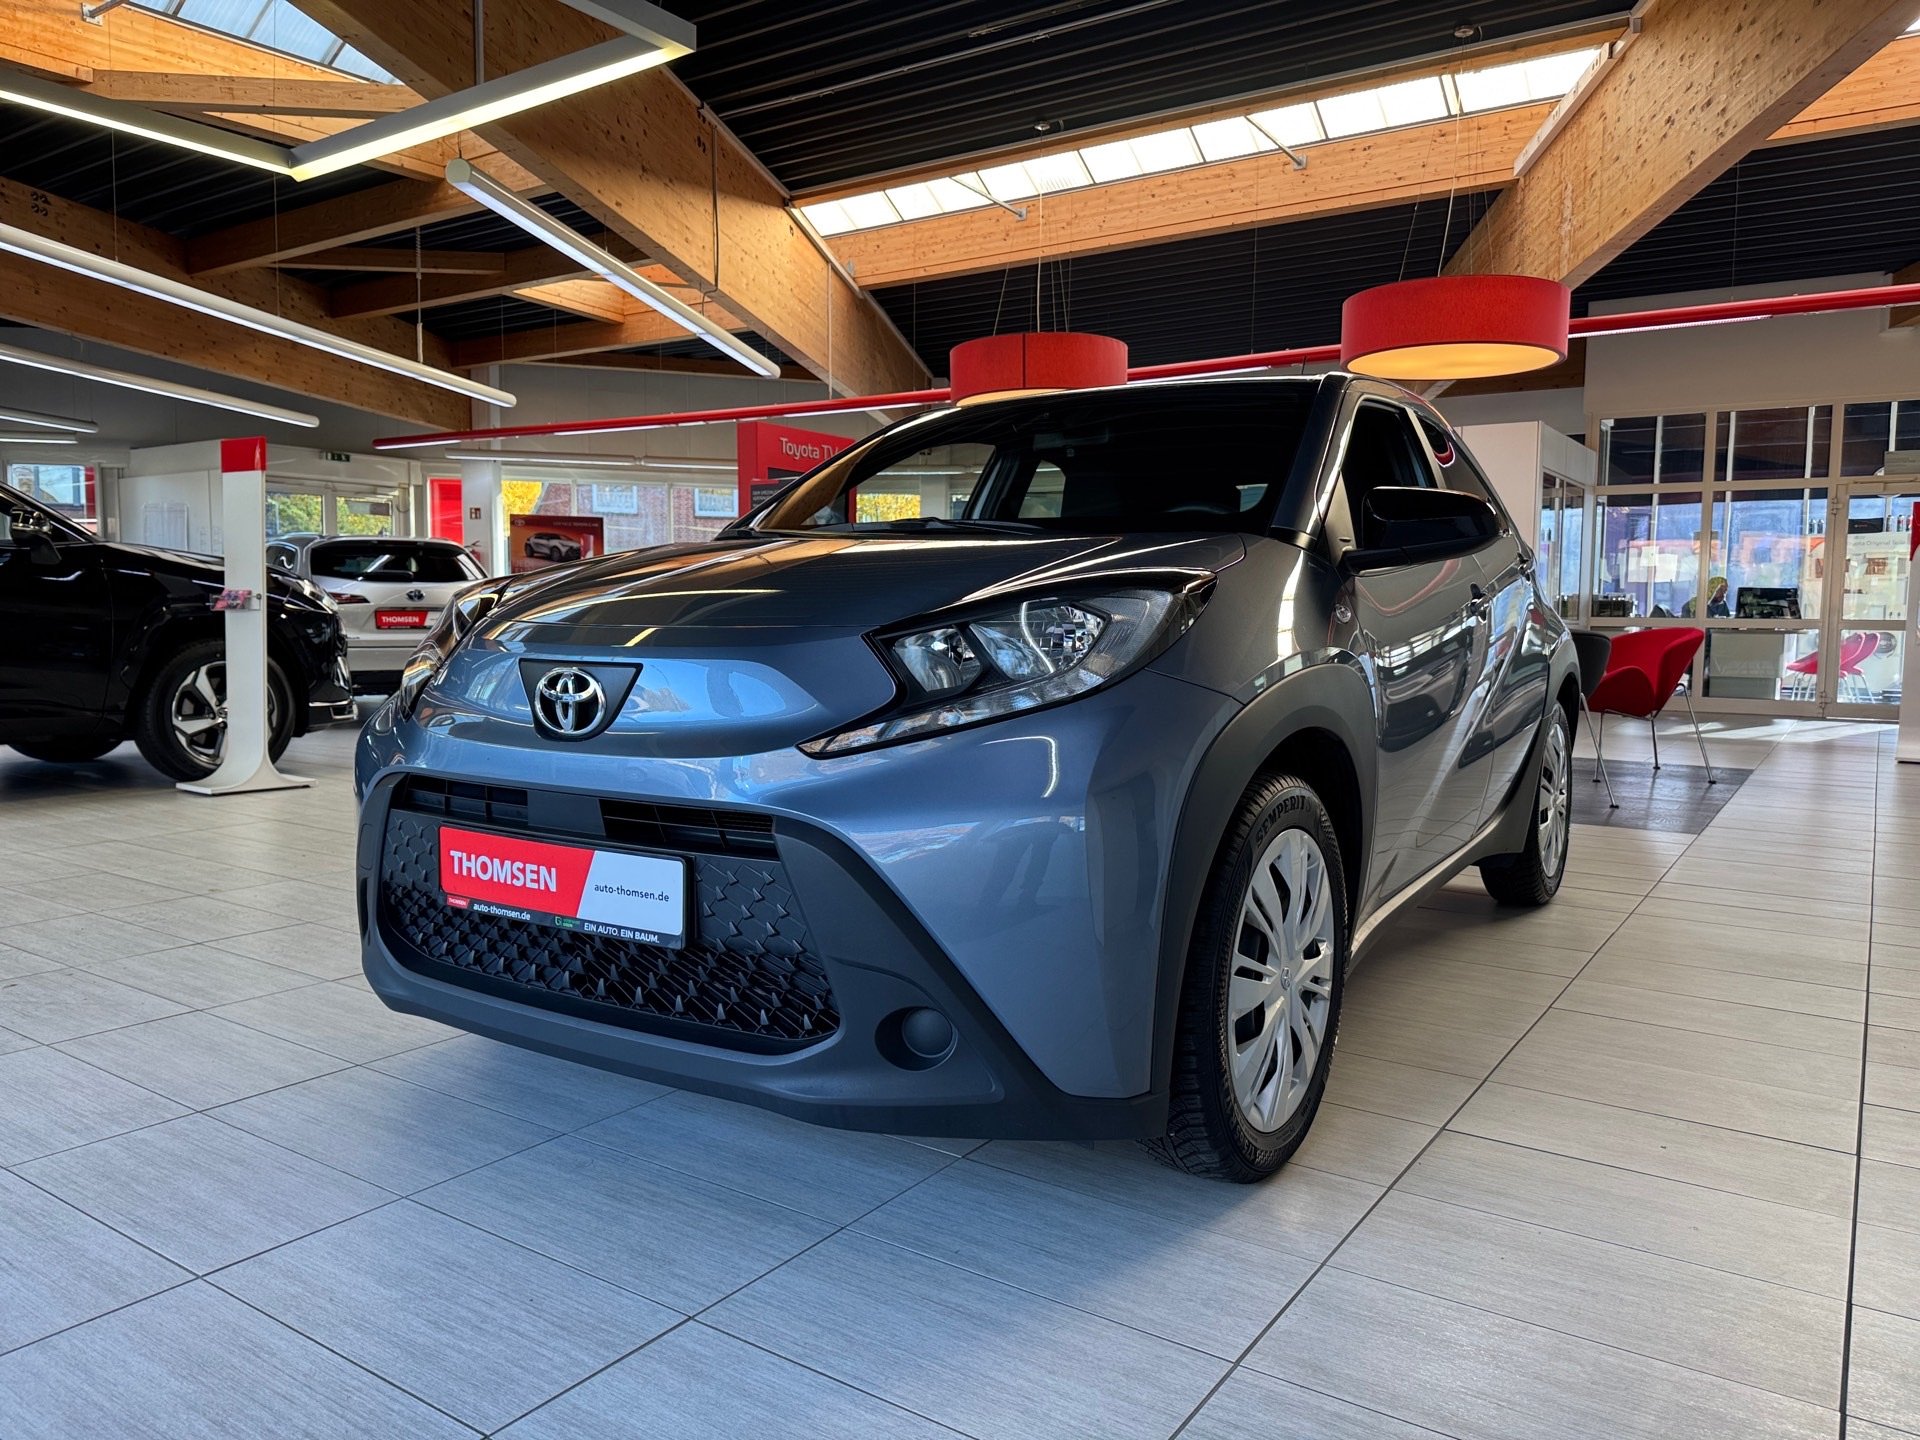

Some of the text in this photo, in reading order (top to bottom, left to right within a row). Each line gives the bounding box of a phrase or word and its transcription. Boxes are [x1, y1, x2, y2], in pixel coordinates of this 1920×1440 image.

[780, 437, 820, 460] Toyota
[1256, 795, 1306, 844] SEMPERIT
[450, 850, 557, 893] THOMSEN
[448, 897, 467, 906] THOMSEN
[594, 884, 670, 902] auto-thomsen.de
[473, 902, 531, 921] auto-thomsen.de
[583, 922, 597, 933] EIN
[597, 925, 620, 937] AUTO.
[620, 929, 634, 939] EIN
[634, 932, 660, 944] BAUM.
